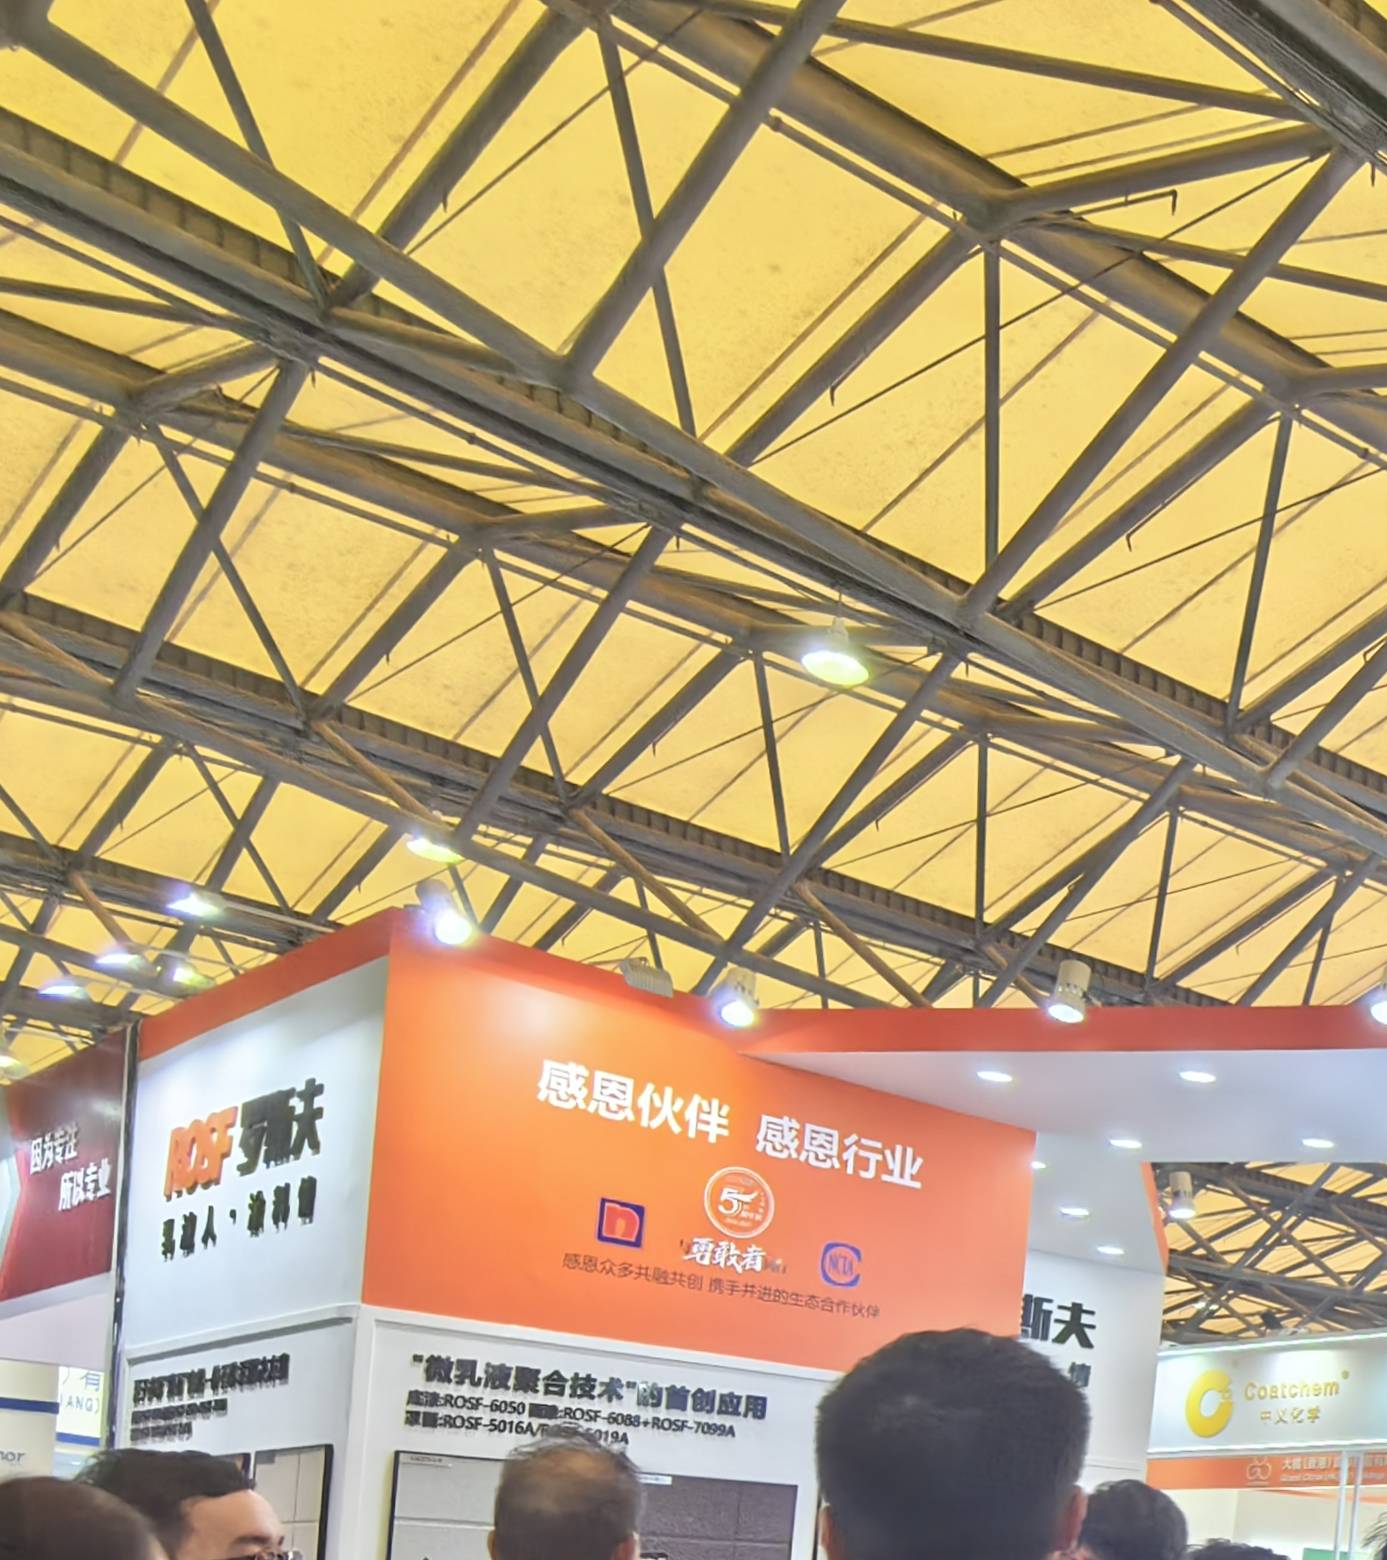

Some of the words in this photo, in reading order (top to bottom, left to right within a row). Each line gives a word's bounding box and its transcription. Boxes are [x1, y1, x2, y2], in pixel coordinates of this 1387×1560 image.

[537, 1058, 730, 1145] 感恩伙伴
[756, 1114, 925, 1190] 感恩行业
[1244, 1381, 1340, 1401] Coatchem
